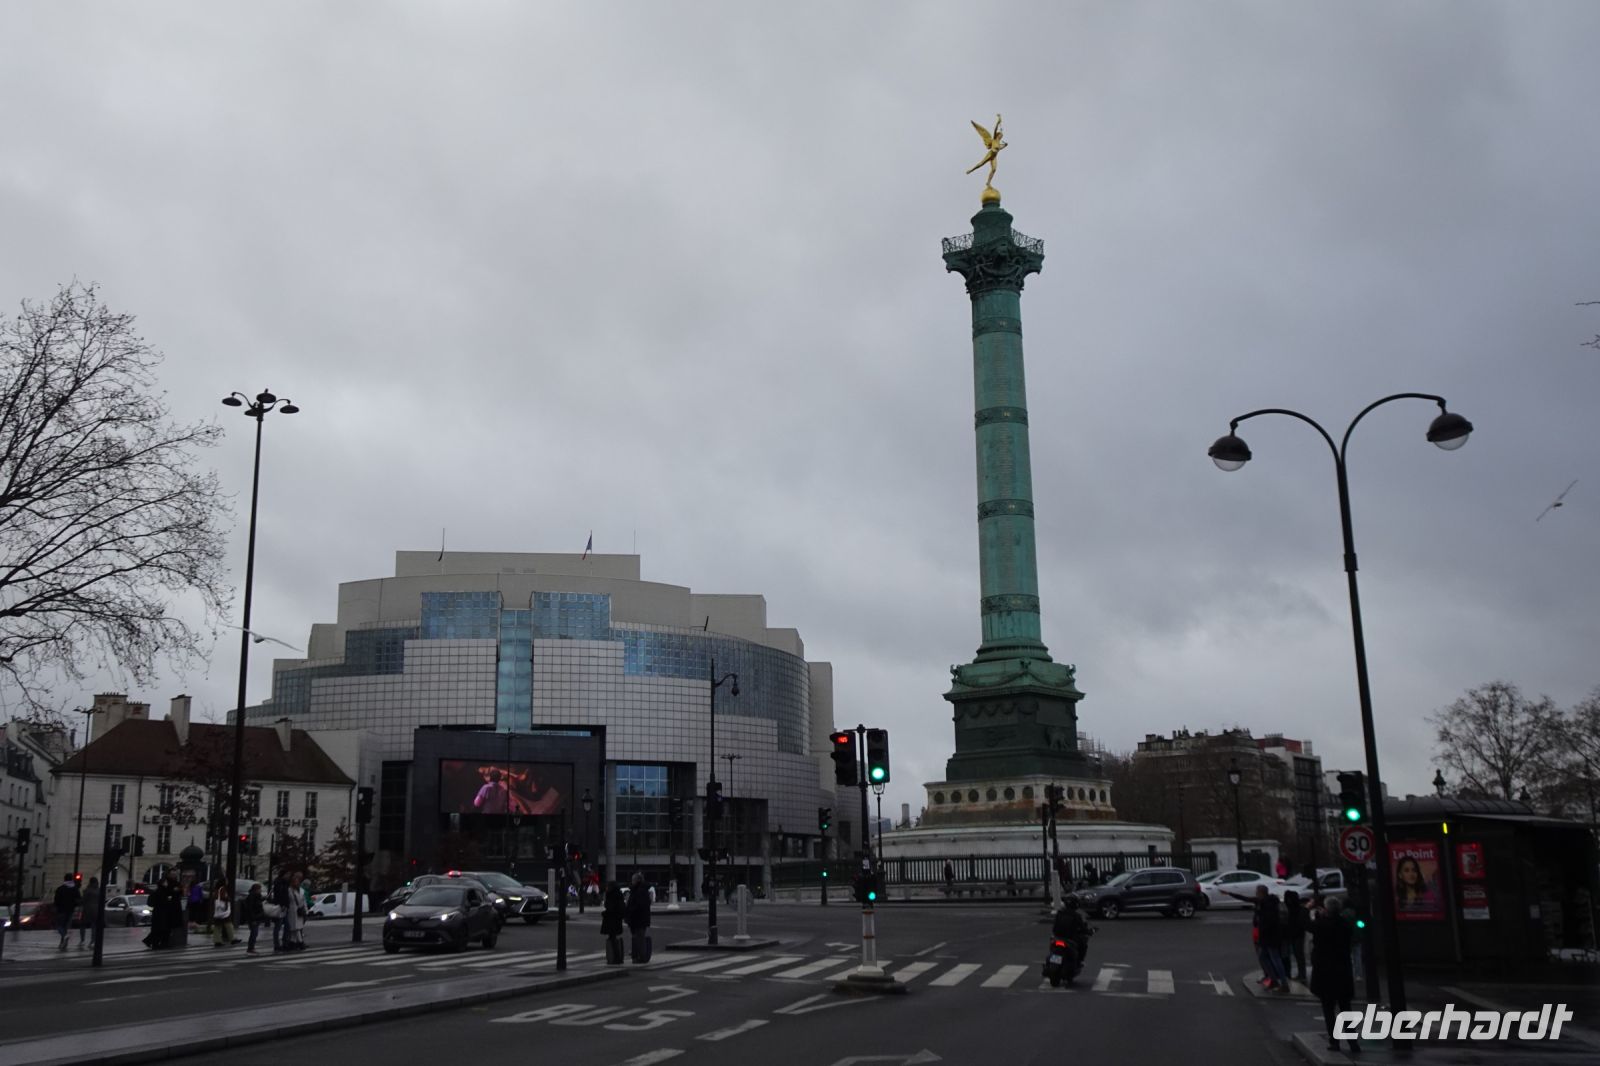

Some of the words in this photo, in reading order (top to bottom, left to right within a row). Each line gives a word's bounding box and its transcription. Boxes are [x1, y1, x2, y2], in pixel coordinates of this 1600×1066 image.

[143, 815, 171, 825] LES
[251, 817, 319, 829] MARCHES
[1348, 836, 1369, 852] 30
[1392, 850, 1405, 860] Le
[1406, 848, 1434, 860] Point
[487, 1003, 697, 1031] BUS
